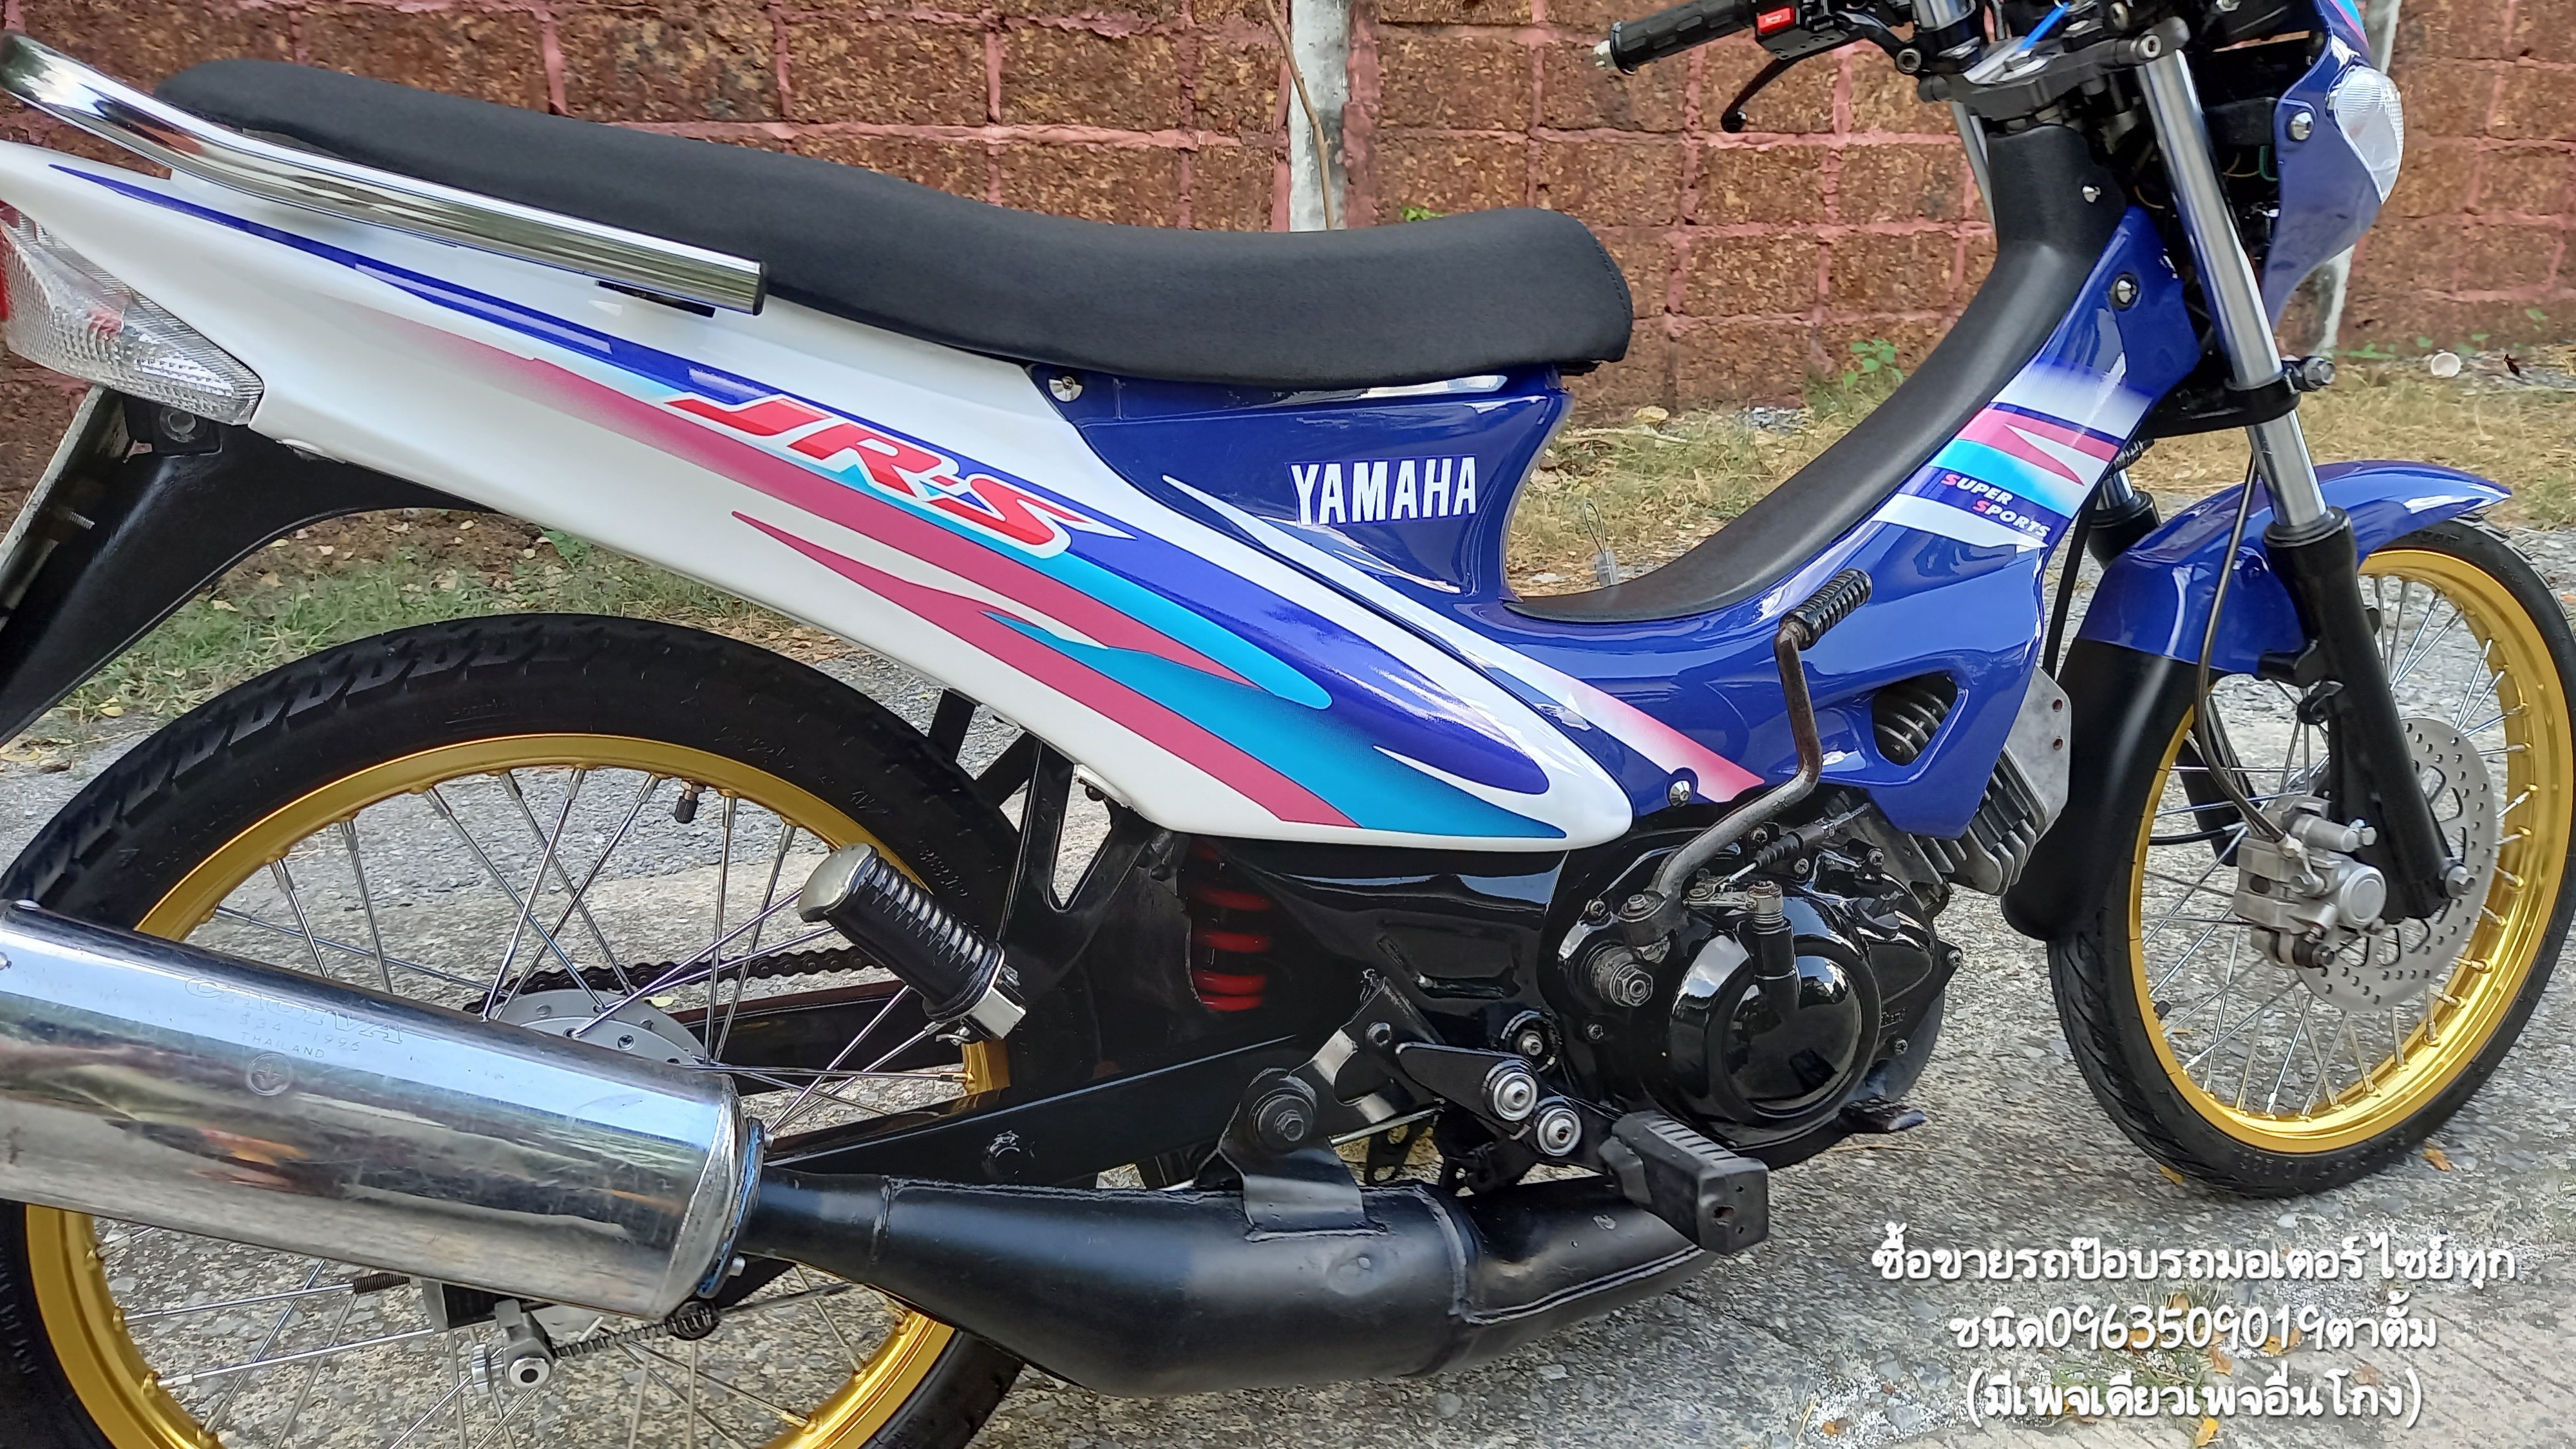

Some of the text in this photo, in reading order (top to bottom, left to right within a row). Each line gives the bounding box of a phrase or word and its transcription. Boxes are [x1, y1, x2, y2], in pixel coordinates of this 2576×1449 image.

[1291, 457, 1476, 525] YAMAHA
[1941, 473, 2013, 506] SUPER
[1973, 500, 2051, 538] SPORTS
[242, 1032, 325, 1059] THAILAND
